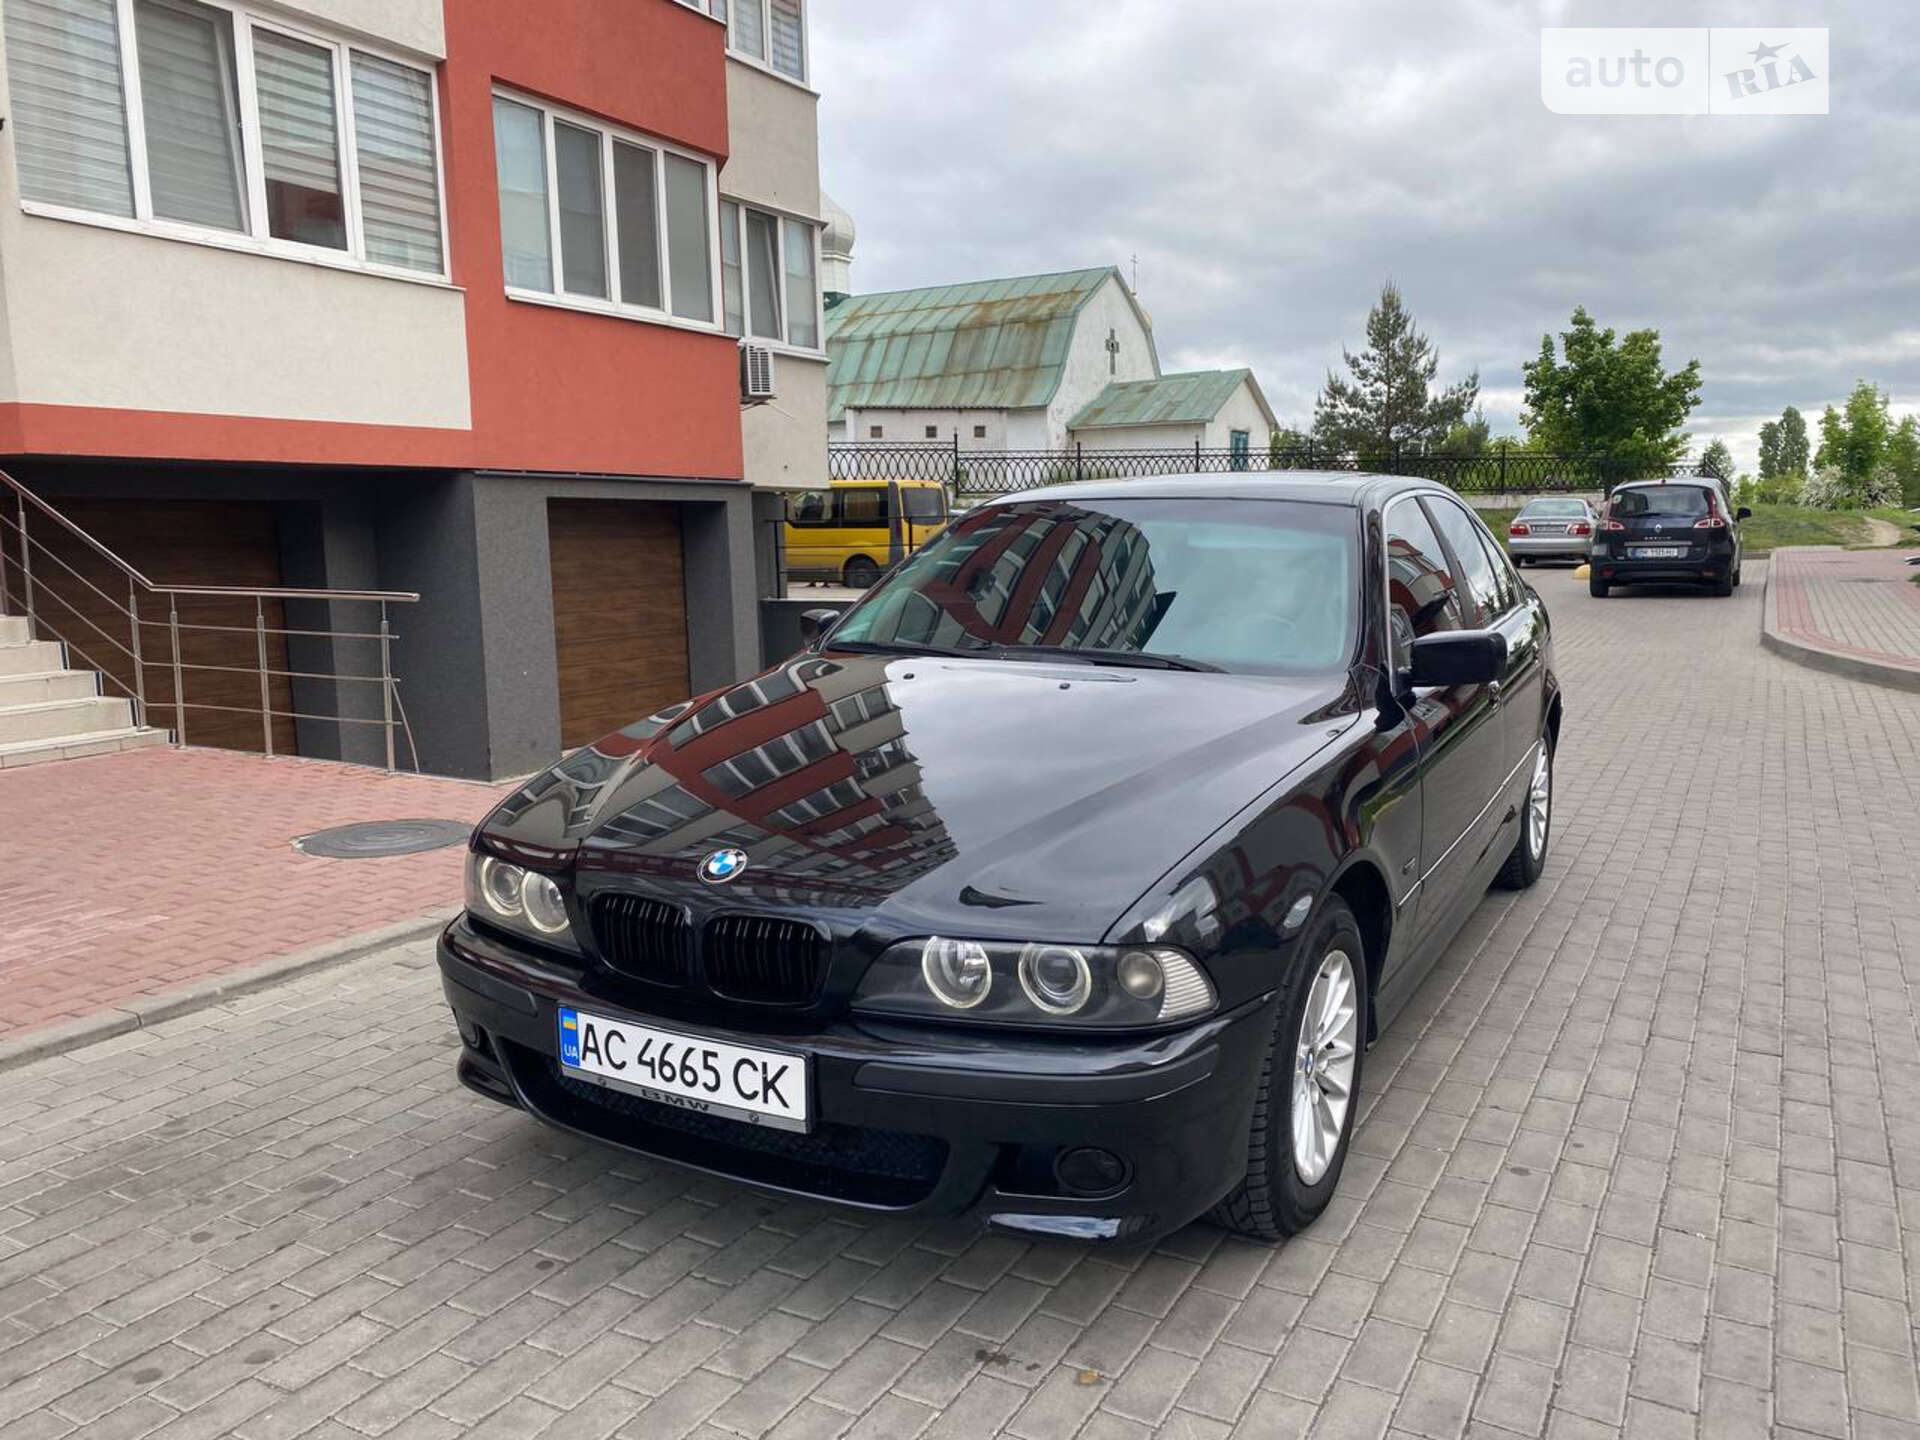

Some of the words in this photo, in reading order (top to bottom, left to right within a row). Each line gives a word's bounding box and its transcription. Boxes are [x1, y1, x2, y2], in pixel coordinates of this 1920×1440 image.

[563, 1043, 579, 1060] UA
[582, 1022, 627, 1070] AC
[637, 1038, 721, 1092] 4665
[732, 1058, 790, 1109] CK
